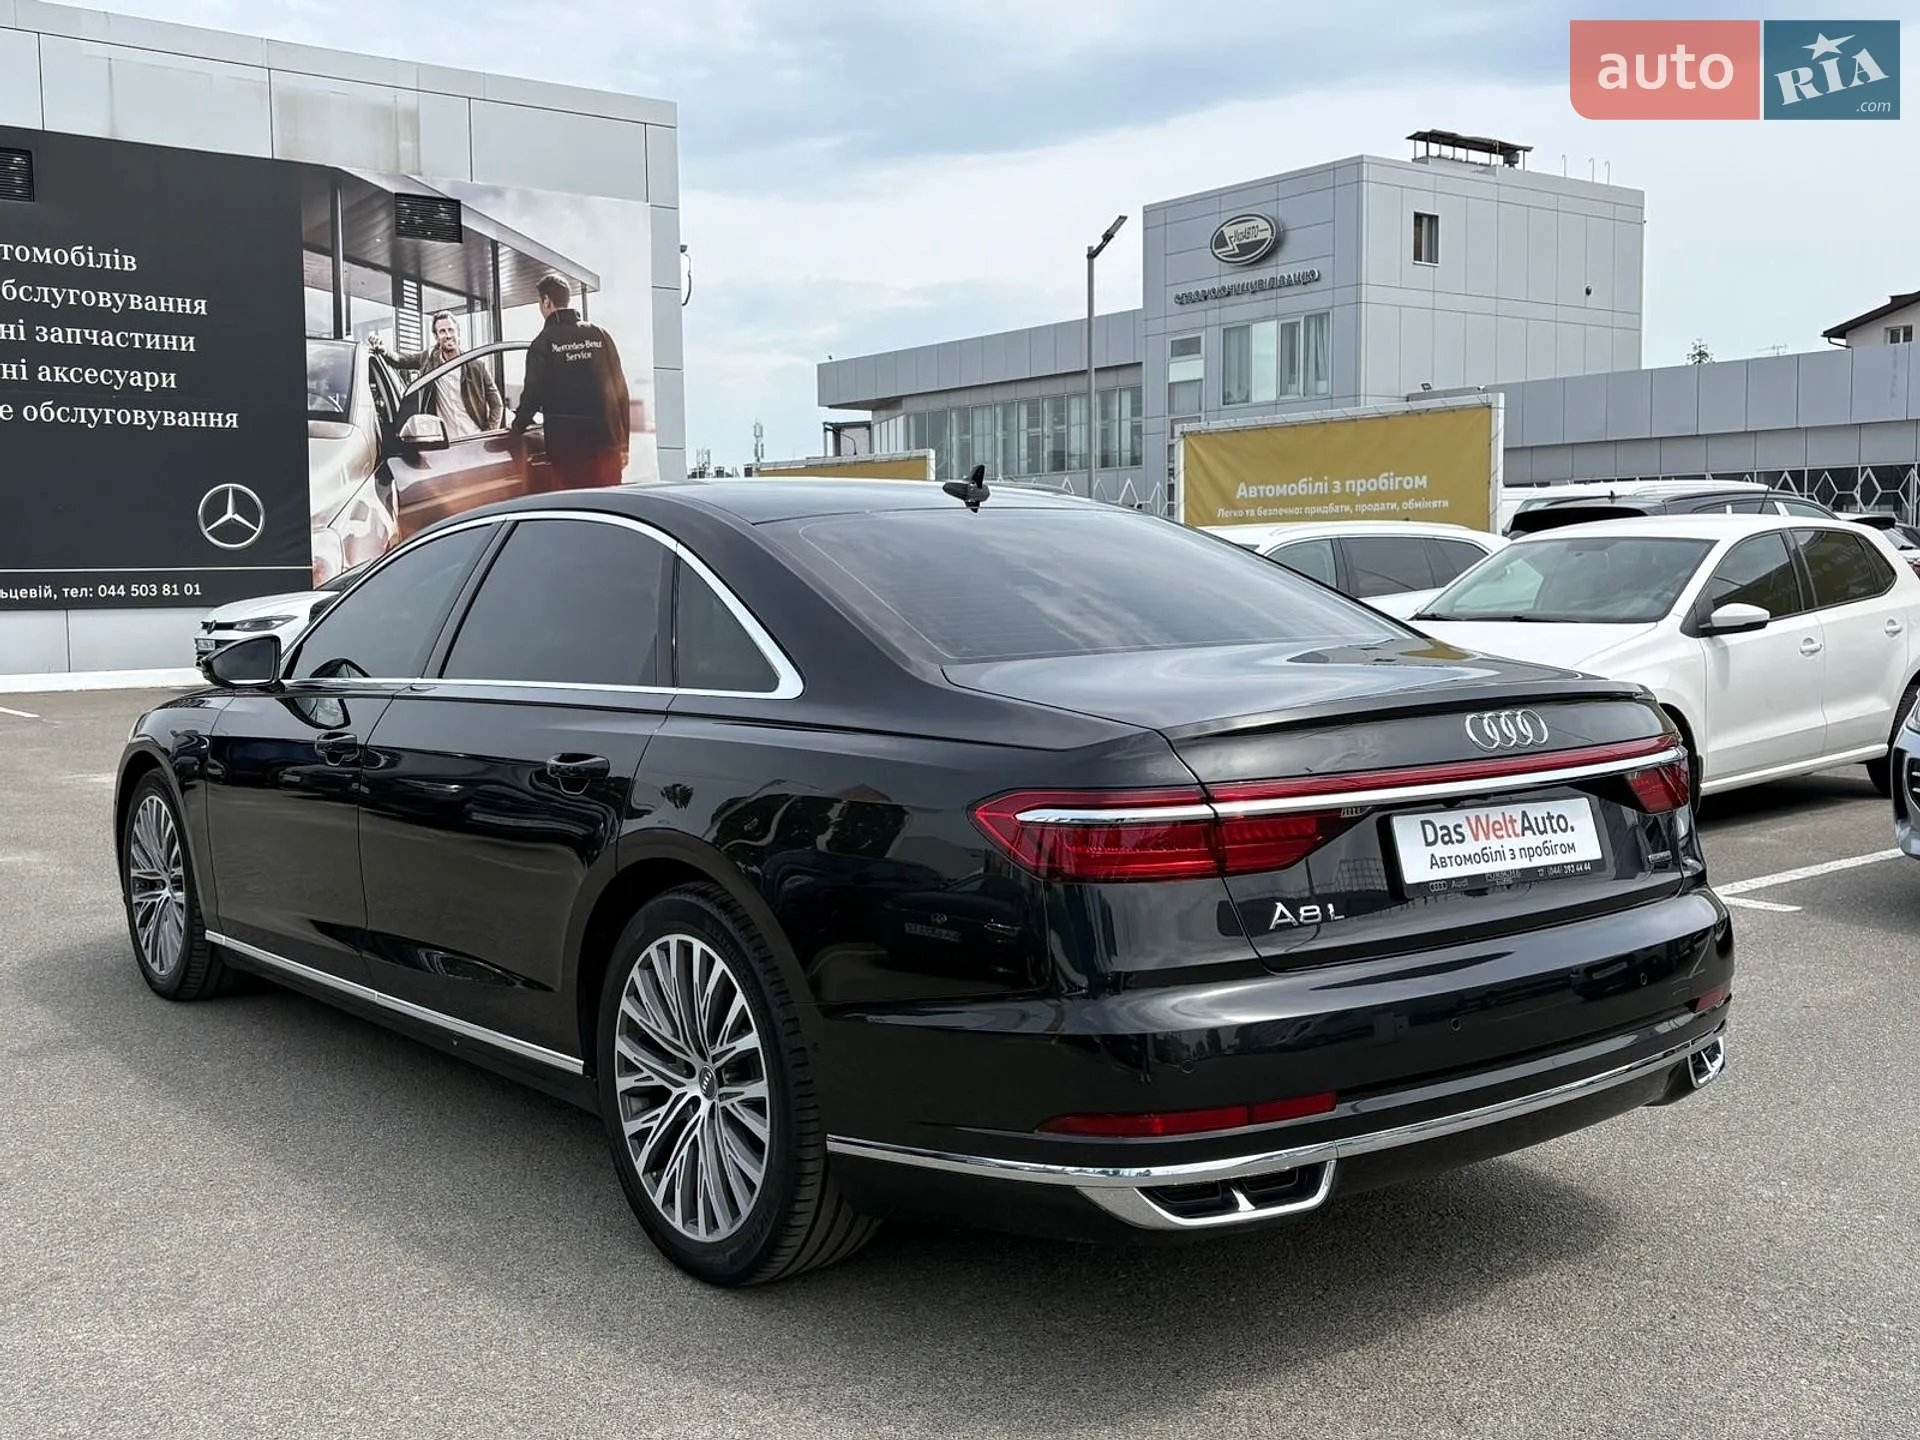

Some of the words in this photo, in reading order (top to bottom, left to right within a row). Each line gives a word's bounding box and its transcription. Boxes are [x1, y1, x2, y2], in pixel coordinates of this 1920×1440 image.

[35, 325, 196, 352] запчастини
[37, 364, 177, 392] аксесуари
[23, 400, 239, 431] обслуговування
[1236, 476, 1329, 499] Автомобілі
[1331, 480, 1342, 494] з
[1345, 471, 1428, 496] пробігом
[62, 587, 94, 598] тел:
[98, 584, 126, 597] 044
[130, 584, 158, 597] 503
[162, 584, 180, 596] 81
[183, 583, 201, 596] 01
[1429, 844, 1507, 870] Автомобілі
[1509, 850, 1517, 861] з
[1519, 840, 1577, 863] пробігом
